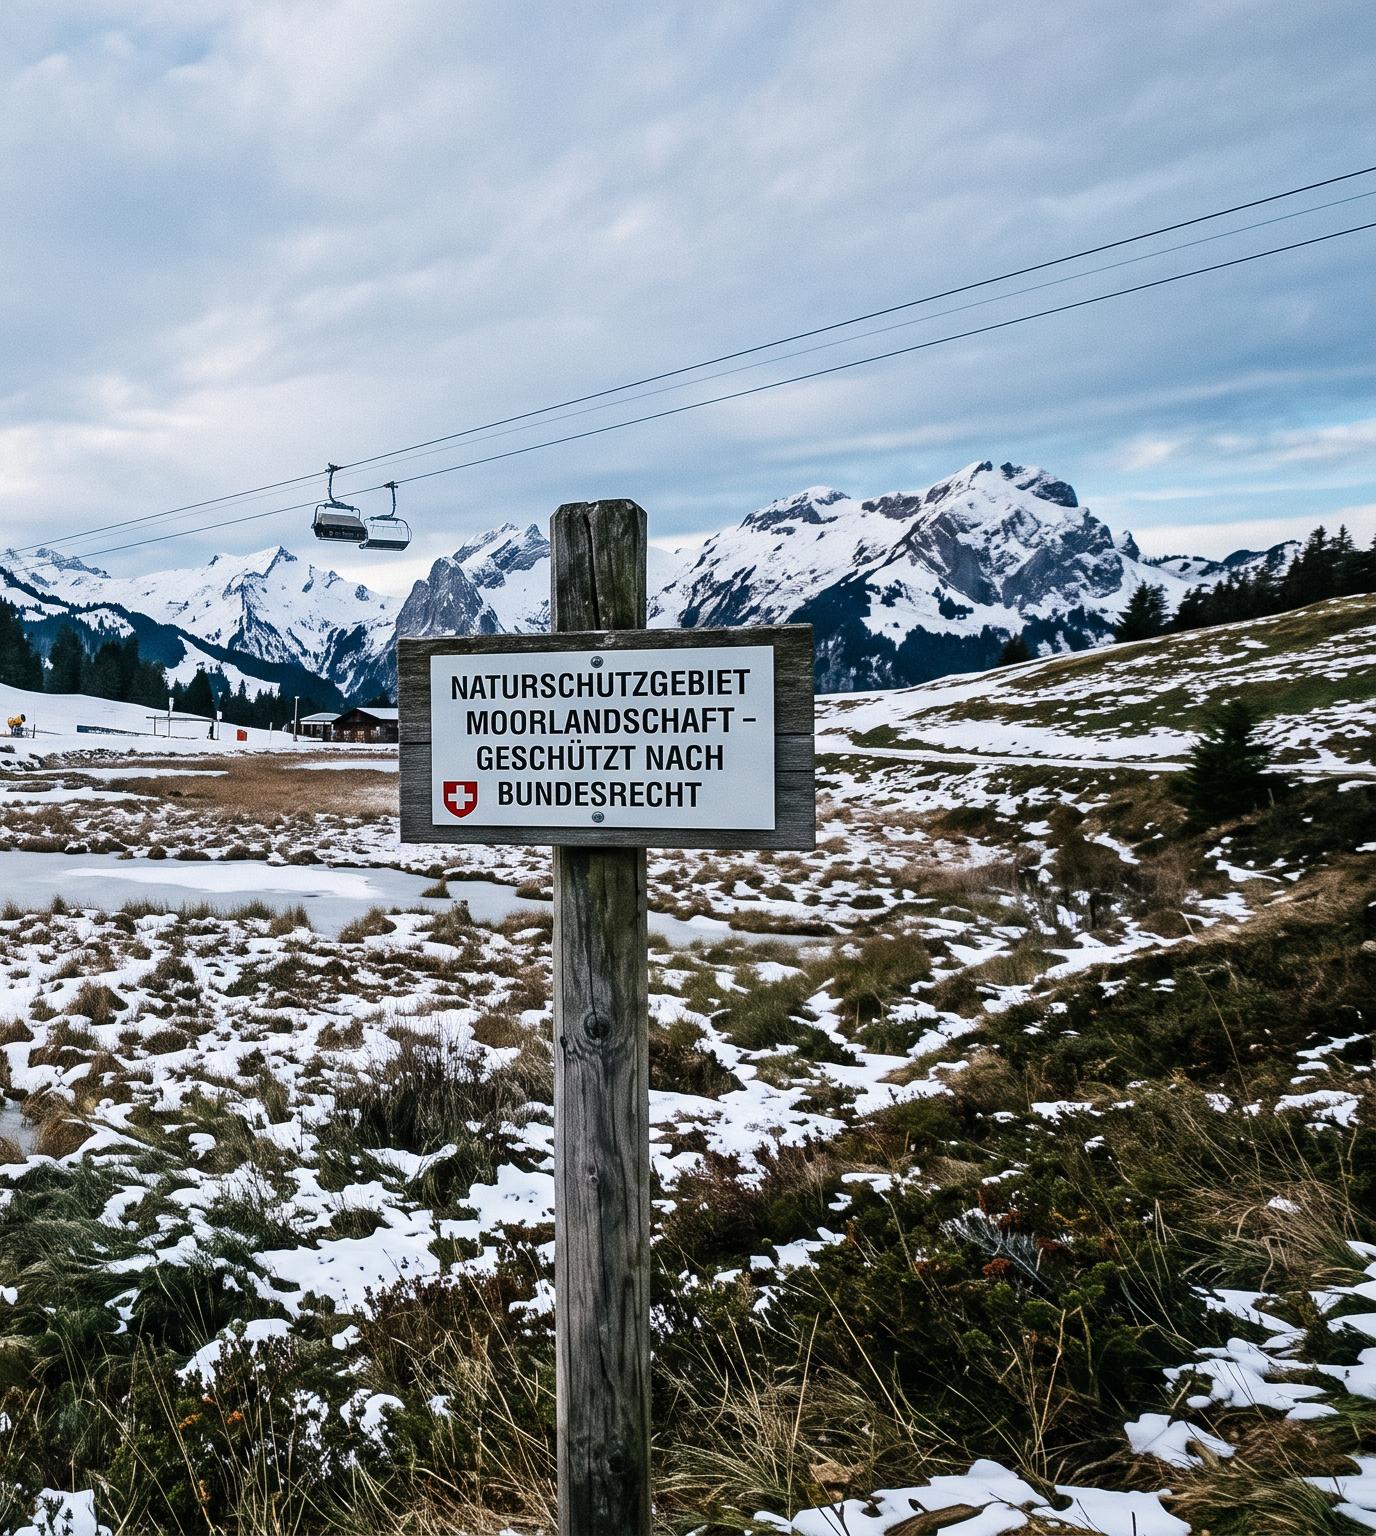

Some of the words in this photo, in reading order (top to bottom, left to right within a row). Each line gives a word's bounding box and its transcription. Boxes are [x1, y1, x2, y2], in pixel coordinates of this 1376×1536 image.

[451, 668, 751, 700] NATURSCHUTZGEBIET
[466, 706, 735, 735] MOORLANDSCHAFT
[476, 739, 637, 771] GESCHÜTZT
[646, 744, 724, 771] NACH
[498, 780, 703, 808] BUNDESRECHT
